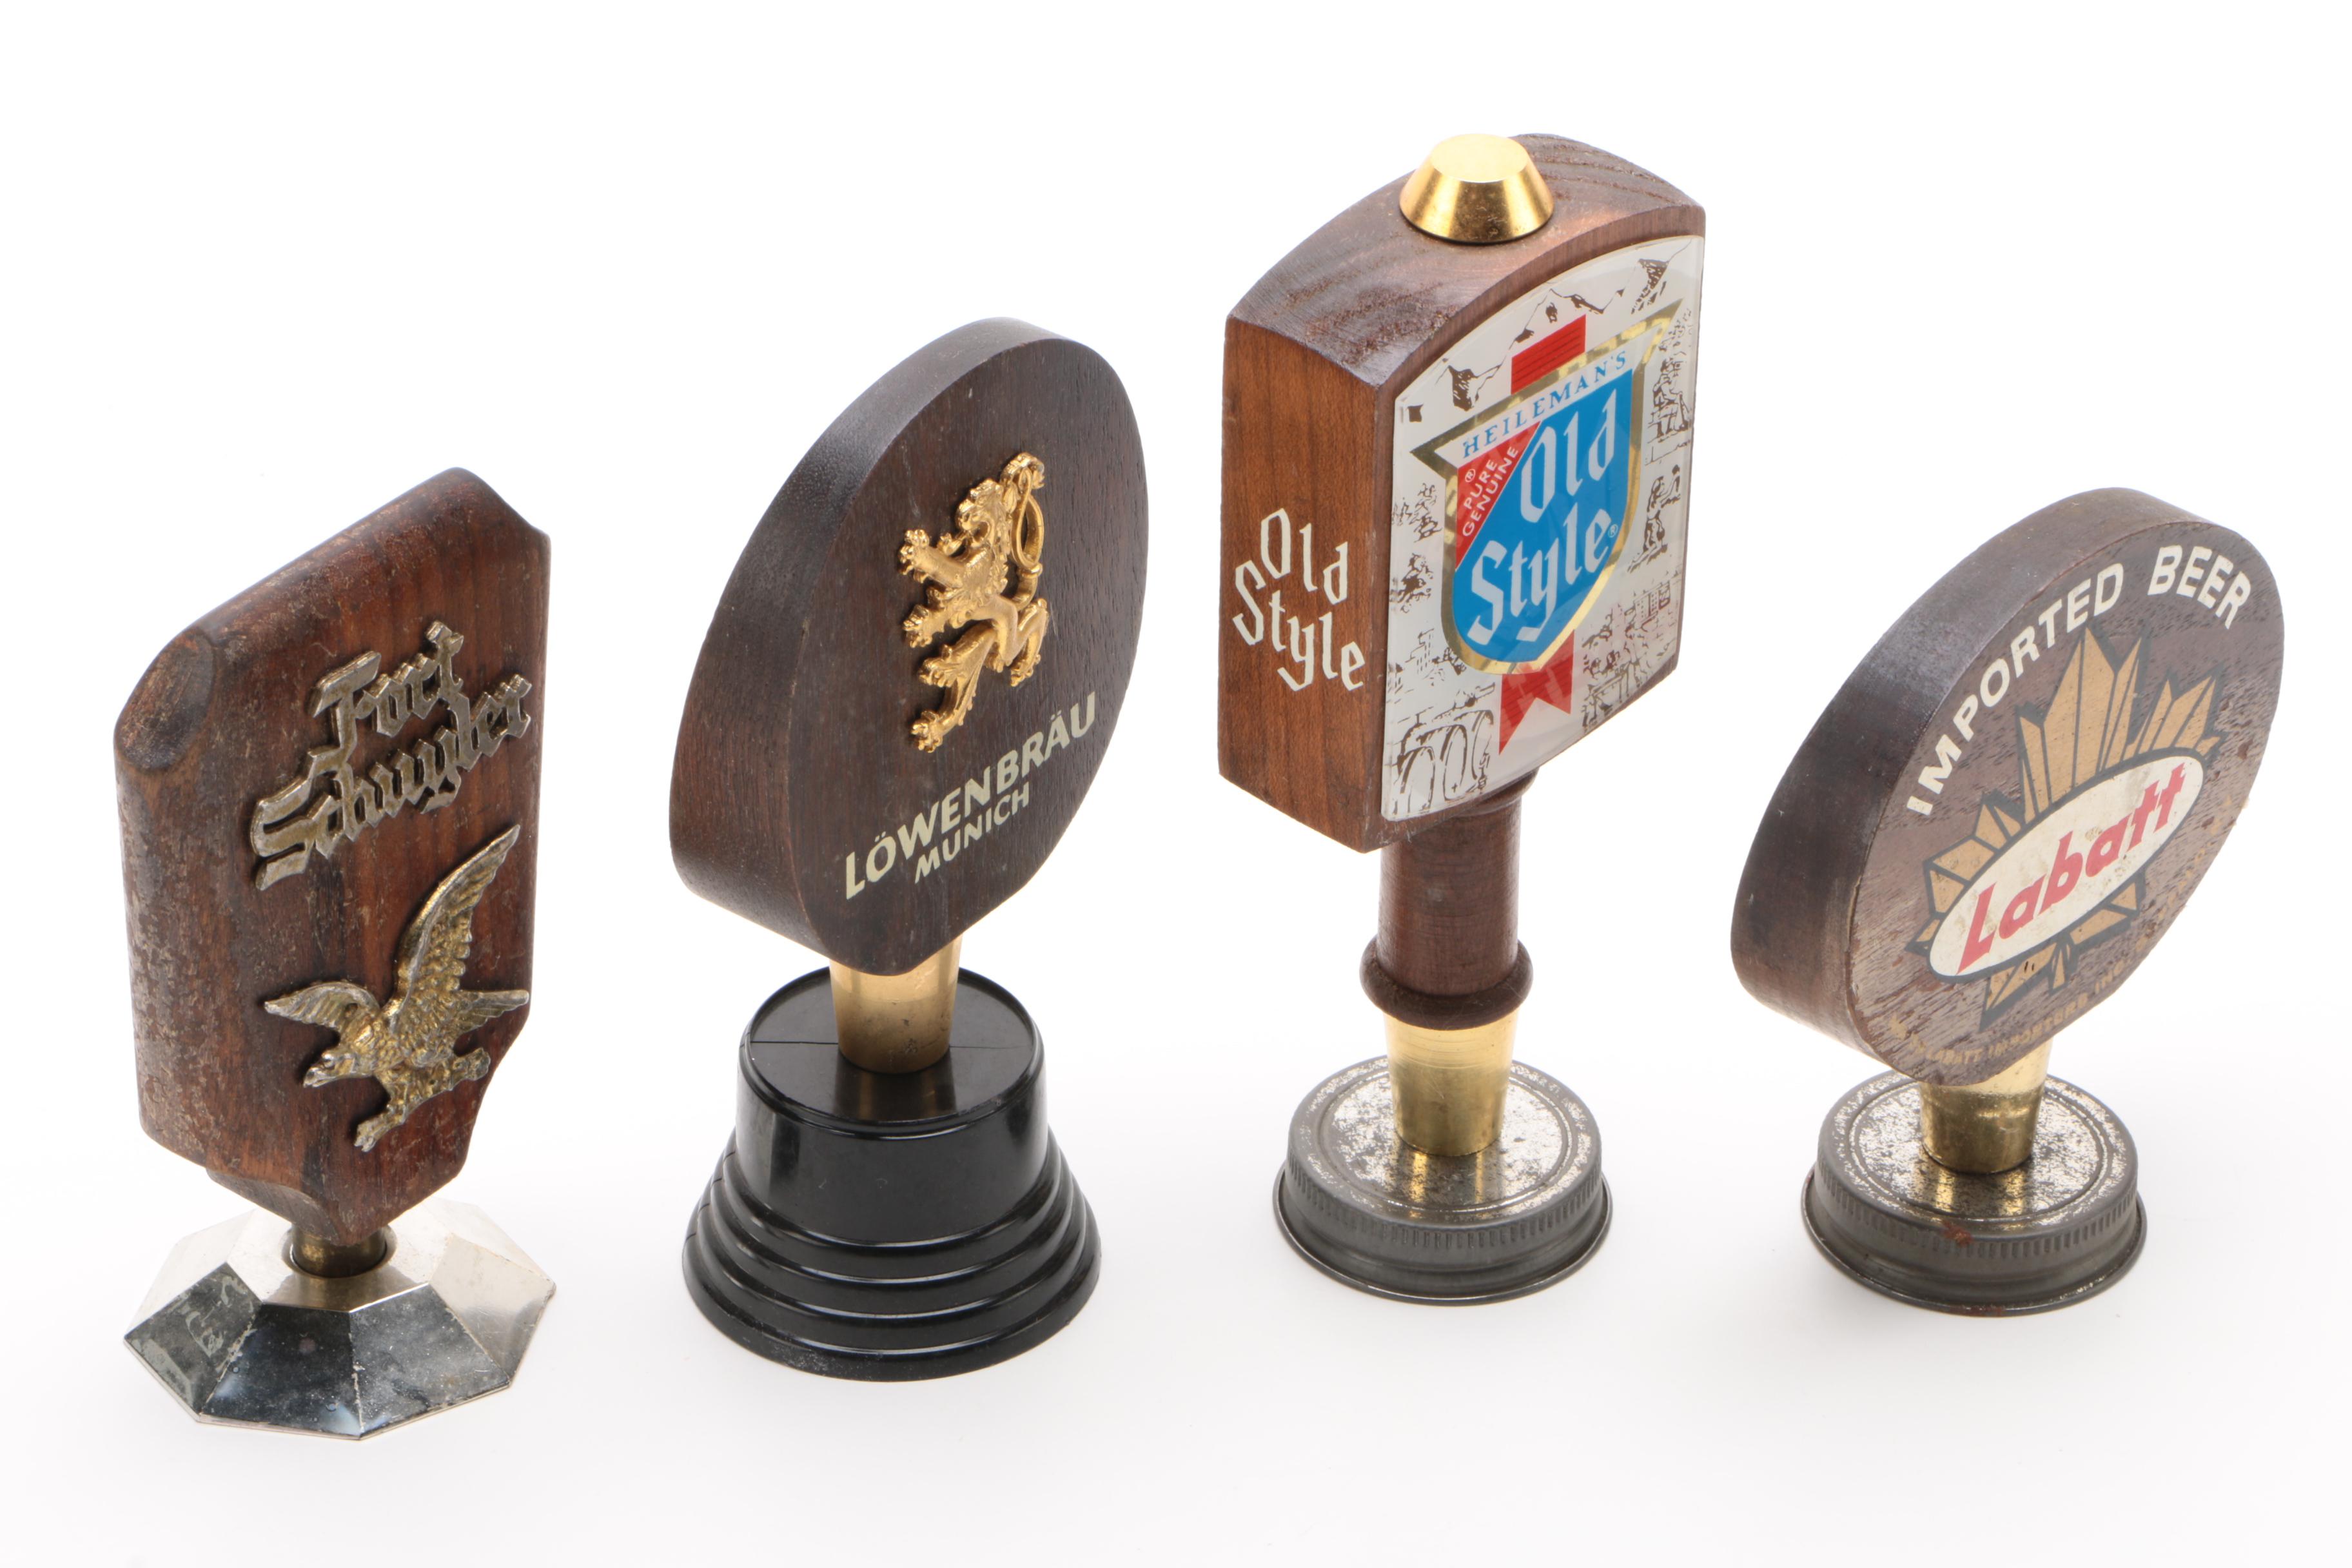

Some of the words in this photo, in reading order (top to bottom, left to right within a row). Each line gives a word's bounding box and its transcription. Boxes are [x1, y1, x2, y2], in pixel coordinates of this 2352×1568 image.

[1463, 350, 1626, 458] HEILEMAN'S
[1520, 388, 1616, 524] Old
[1462, 446, 1519, 537] GENUINE
[1463, 459, 1498, 510] PURE
[1260, 507, 1348, 605] Old
[310, 619, 464, 752] Fort
[1232, 559, 1366, 692] Style
[1906, 562, 2124, 816] IMPORTED
[2147, 544, 2252, 630] BEER
[250, 673, 533, 892] Schuyler
[845, 691, 1095, 900] LÖWENBRÄU
[914, 780, 1030, 884] MUNICH
[1955, 761, 2186, 976] Labatt
